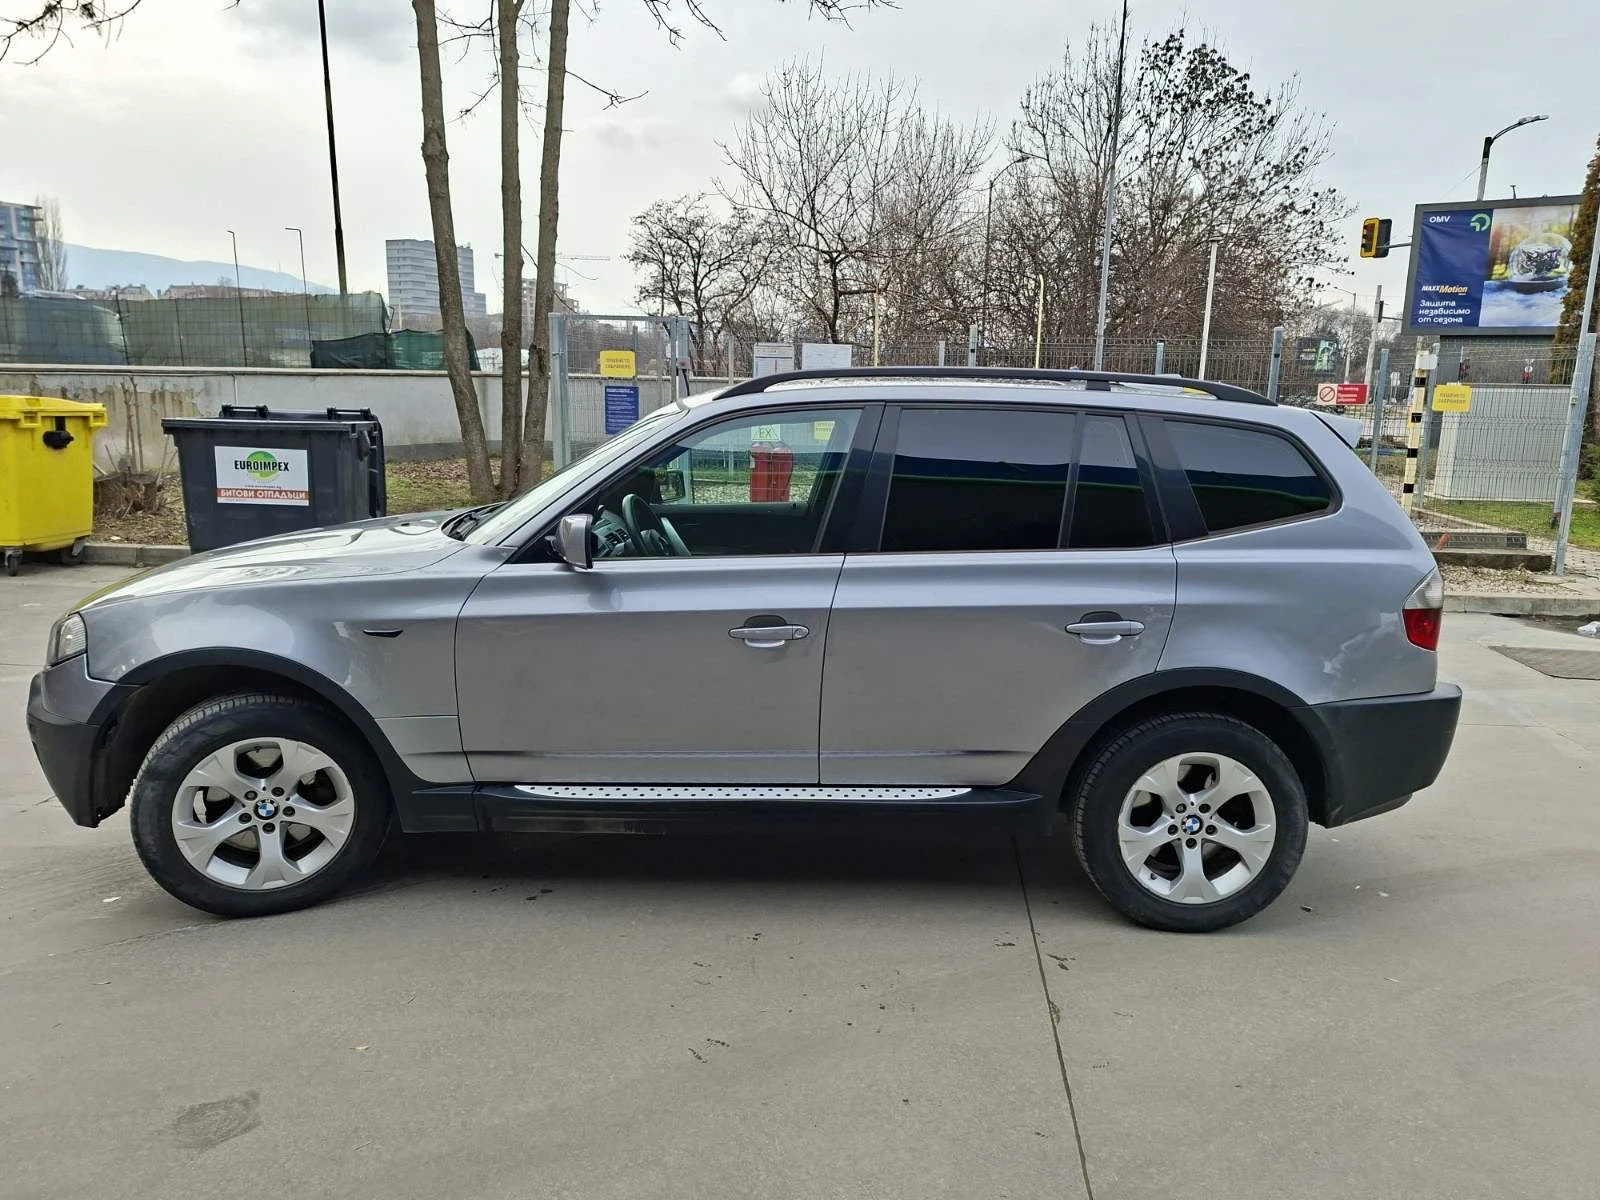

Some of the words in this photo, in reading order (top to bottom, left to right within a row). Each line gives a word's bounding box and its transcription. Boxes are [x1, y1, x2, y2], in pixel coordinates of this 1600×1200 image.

[1429, 215, 1451, 223] OMV
[1419, 308, 1471, 317] независимо
[1433, 317, 1463, 325] сезона
[759, 428, 772, 438] EX
[234, 460, 289, 471] EUROIMPEX
[221, 489, 254, 497] БИТОВИ
[256, 490, 305, 499] ОТПАДЪЦИ
